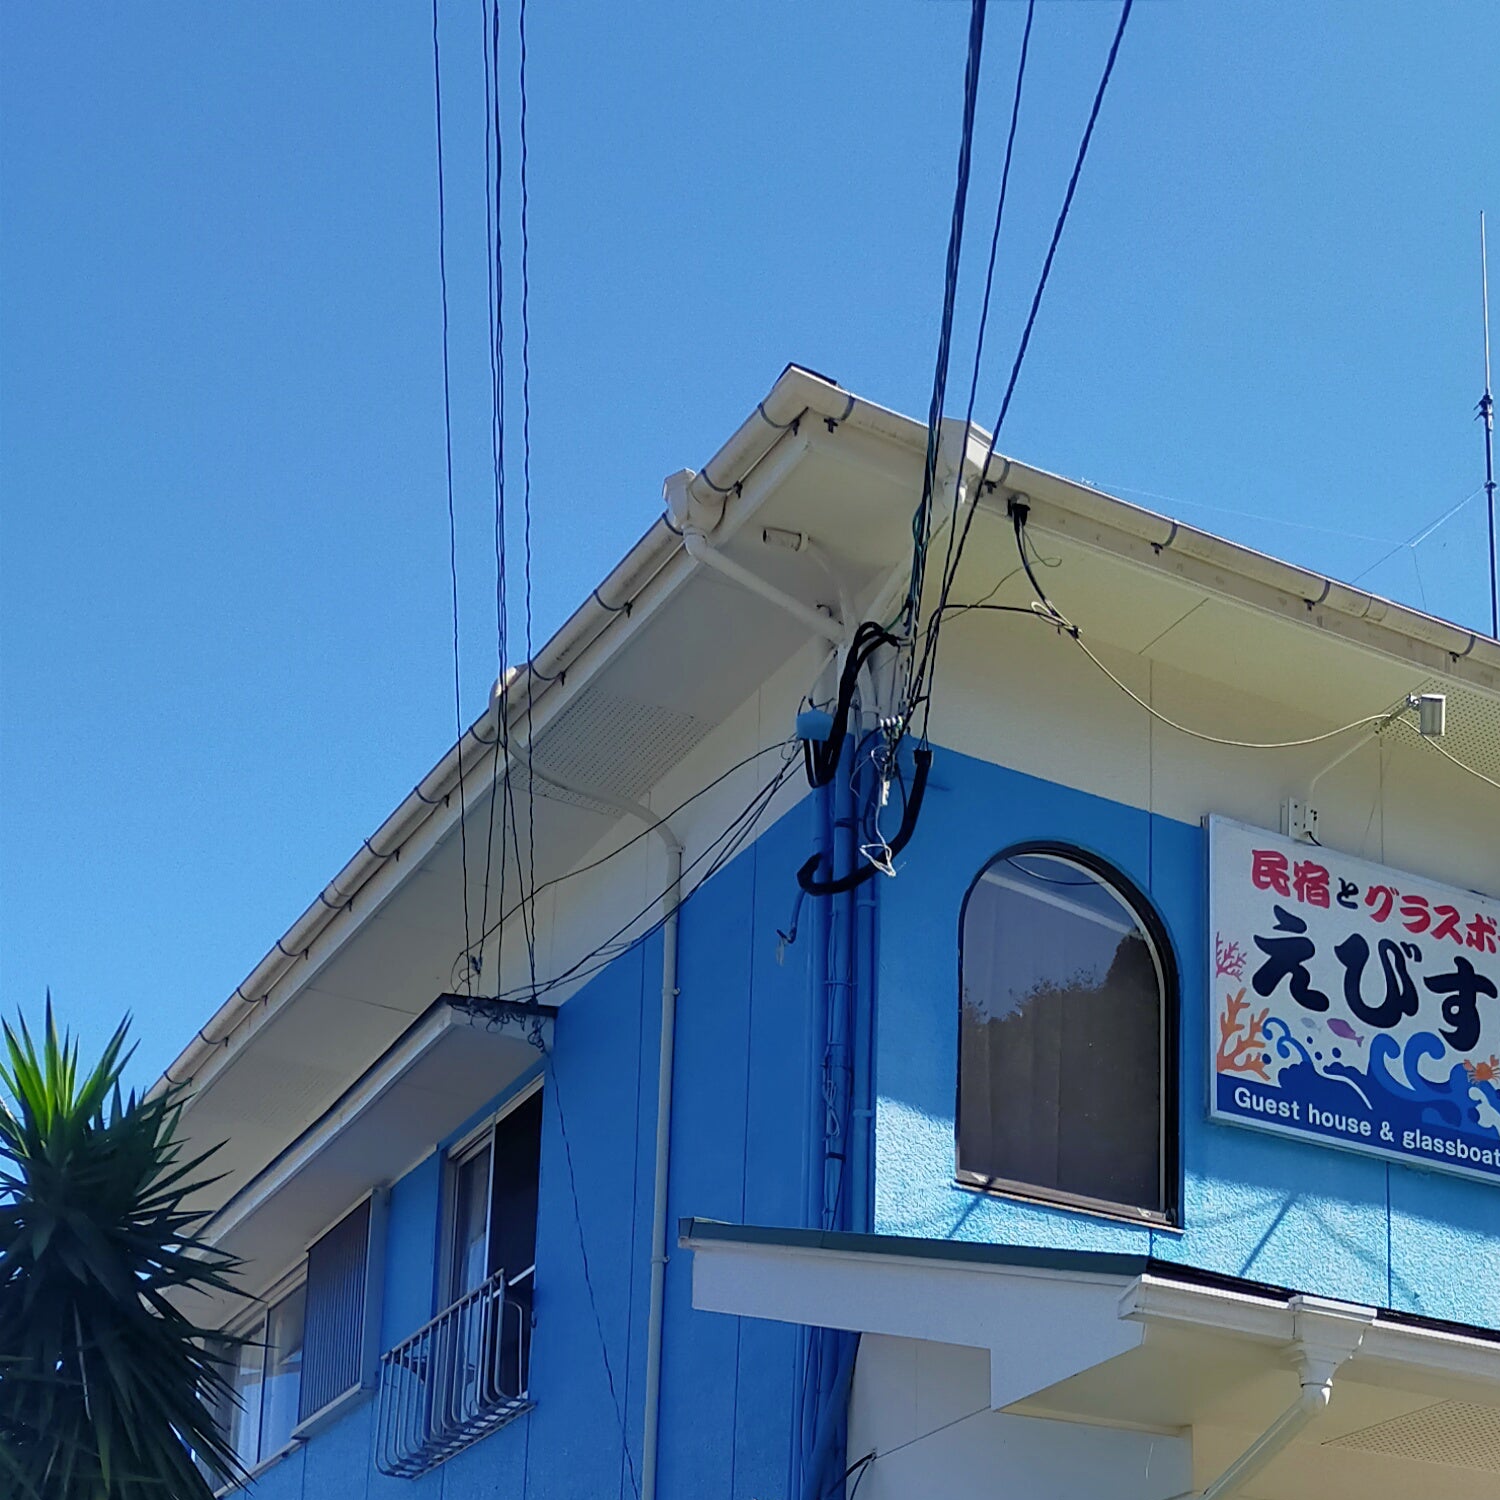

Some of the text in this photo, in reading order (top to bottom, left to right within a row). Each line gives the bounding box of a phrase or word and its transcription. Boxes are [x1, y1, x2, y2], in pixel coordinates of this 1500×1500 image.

[1234, 1087, 1300, 1121] Guest
[1308, 1103, 1371, 1137] house
[1379, 1122, 1394, 1142] &
